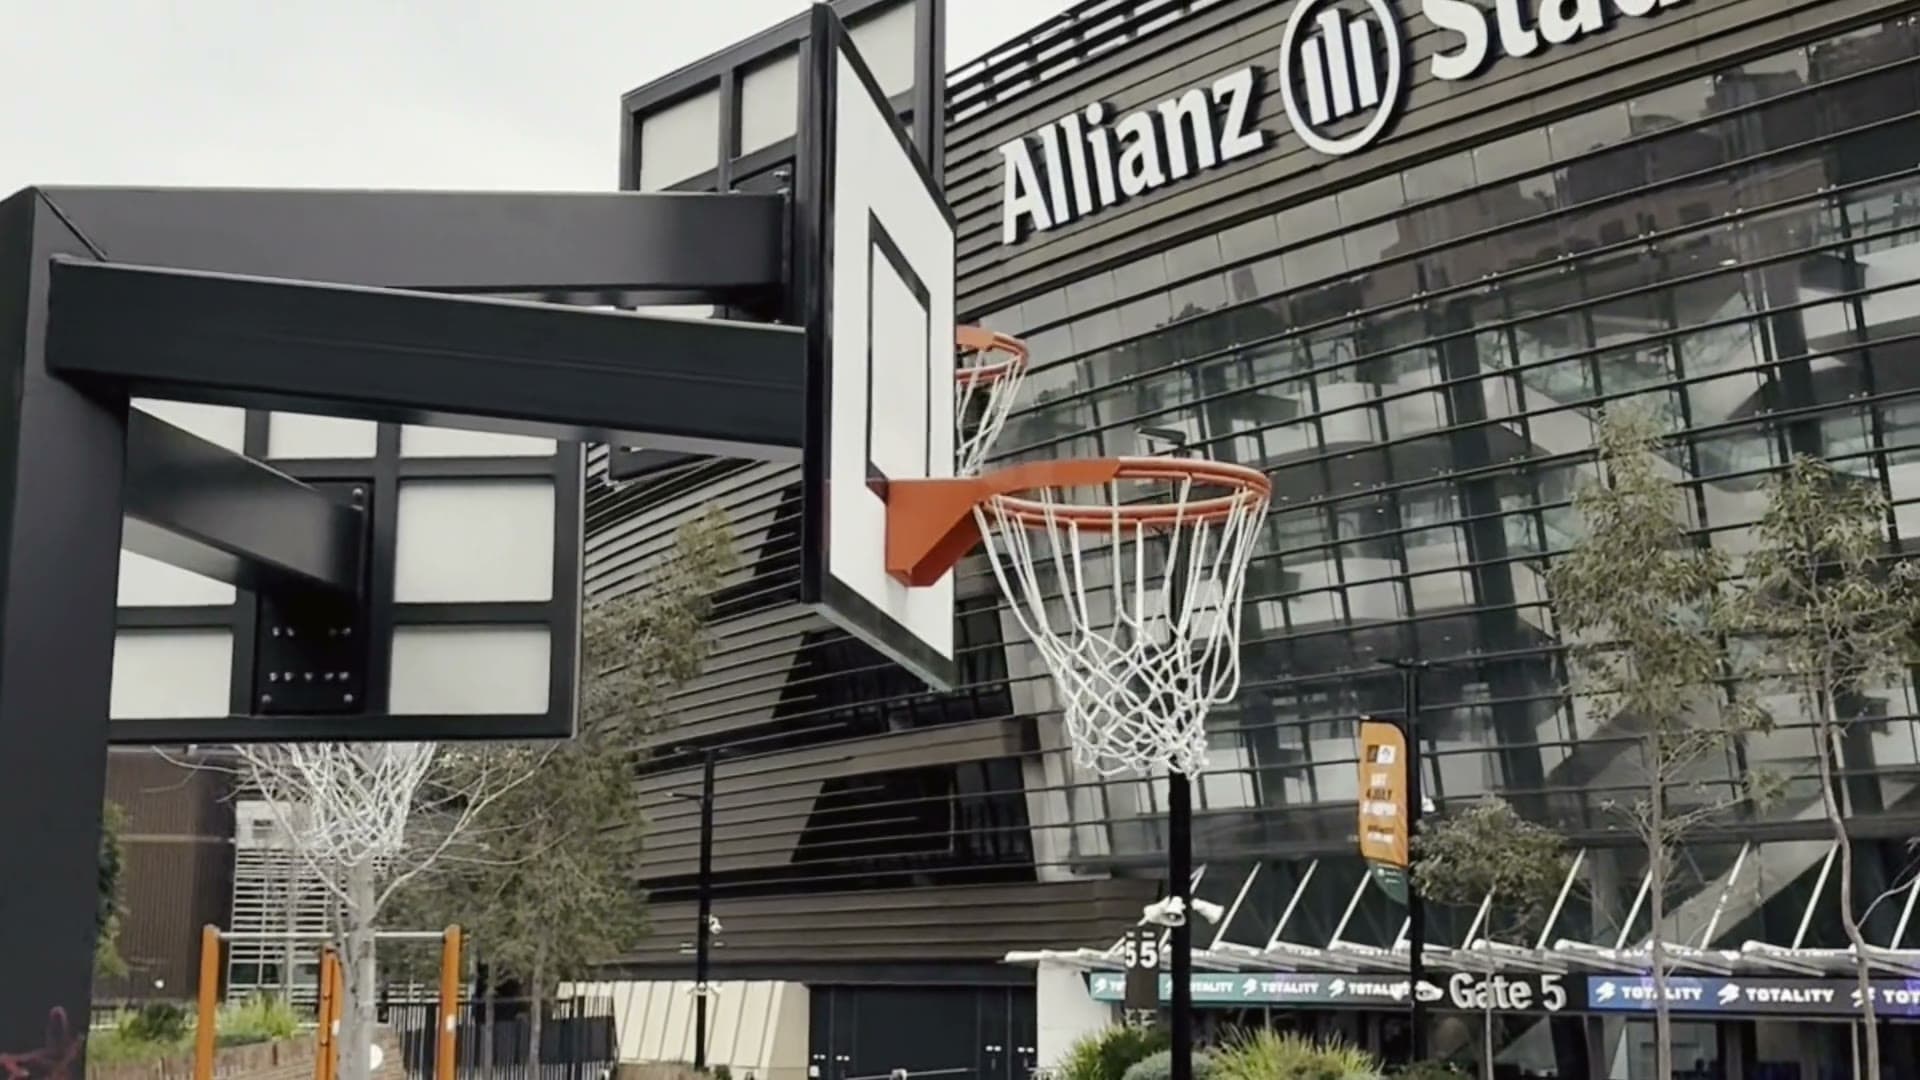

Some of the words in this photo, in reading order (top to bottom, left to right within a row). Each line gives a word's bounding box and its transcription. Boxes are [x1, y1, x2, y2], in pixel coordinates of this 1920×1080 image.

[1001, 66, 1266, 244] Allianz
[1422, 0, 1680, 80] Sta
[1261, 982, 1319, 994] TOTALITY
[1450, 972, 1532, 1009] Gate
[1541, 974, 1567, 1011] 5
[1746, 987, 1834, 1003] TOTALITY
